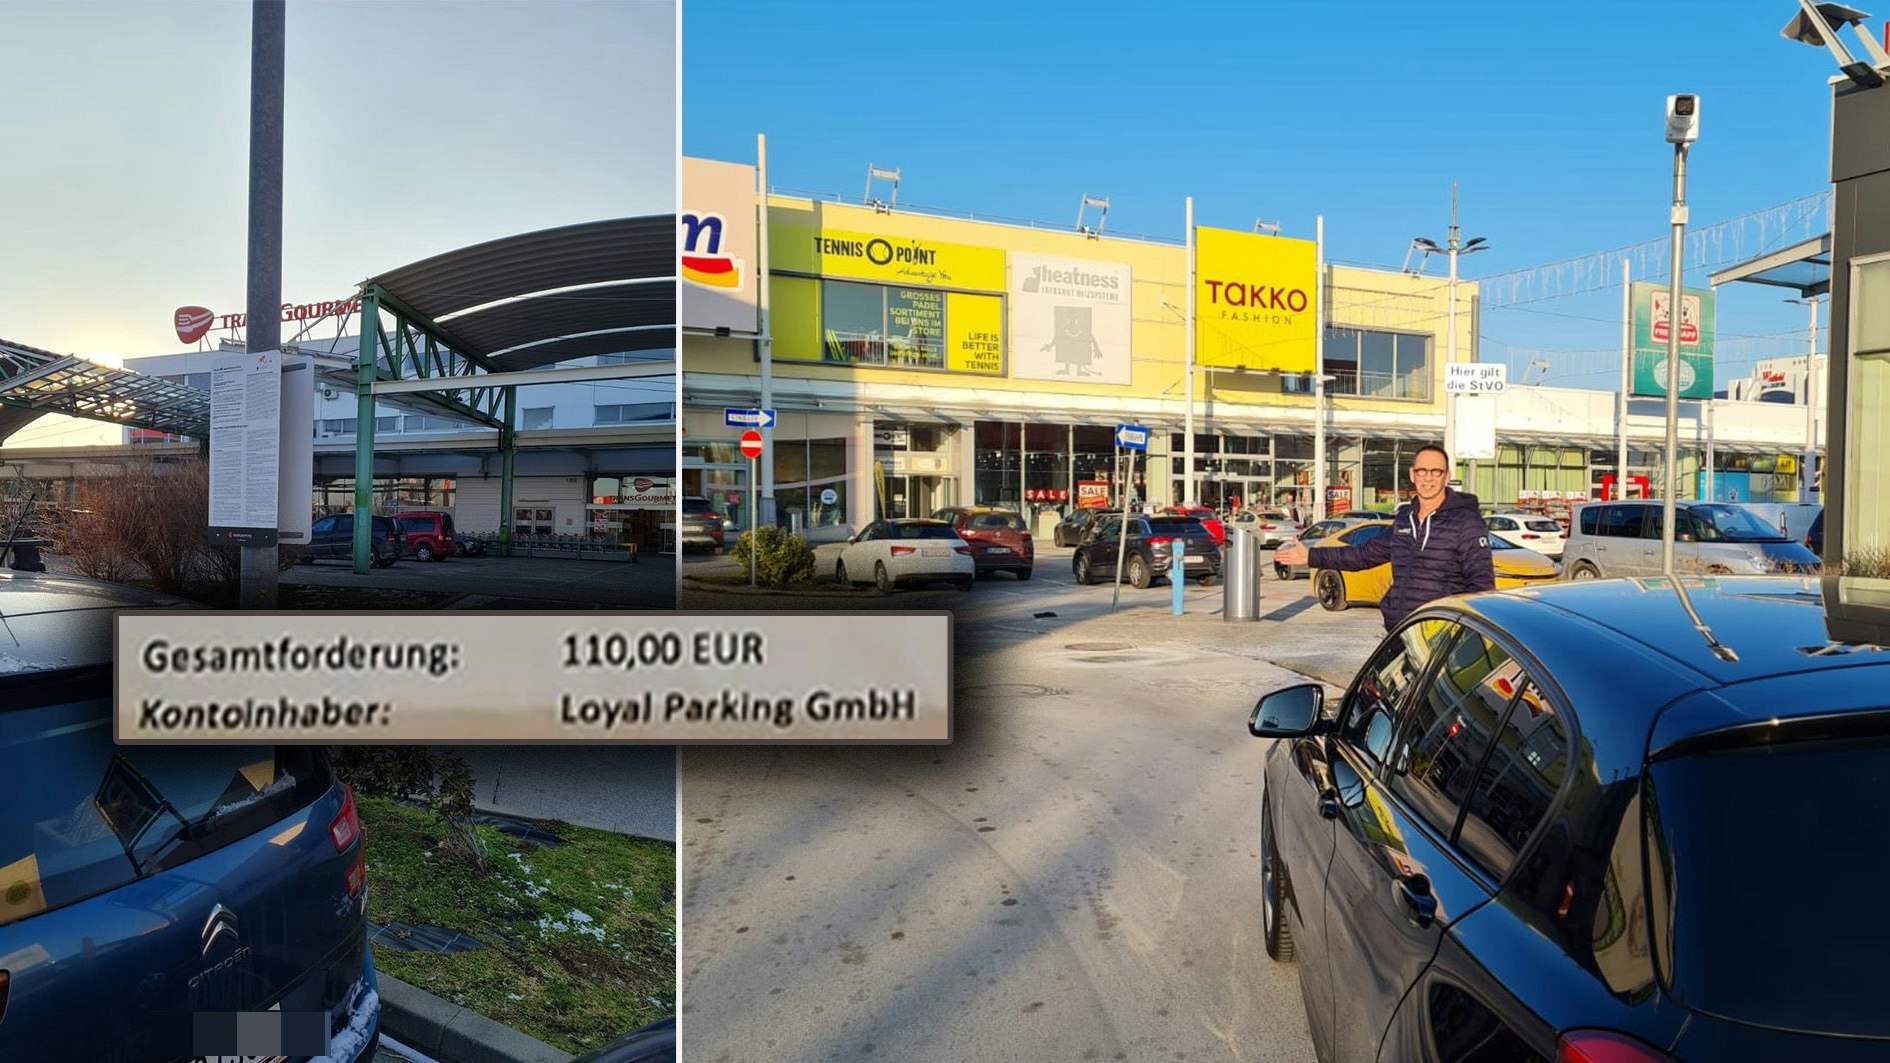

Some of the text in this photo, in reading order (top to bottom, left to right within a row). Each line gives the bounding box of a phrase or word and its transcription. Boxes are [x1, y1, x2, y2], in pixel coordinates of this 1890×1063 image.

[813, 236, 936, 265] TENNIS POINT
[1042, 265, 1119, 290] heatness
[900, 290, 941, 302] GROSSES
[912, 301, 941, 311] PADEL
[889, 307, 941, 320] SORTIMENT
[1221, 311, 1292, 326] FASHION
[911, 327, 941, 337] STORE
[969, 332, 999, 342] LIFE IS
[962, 341, 999, 352] BETTER
[974, 351, 999, 361] WITH
[966, 360, 999, 371] TENNIS
[1450, 366, 1500, 379] Hier gilt
[1447, 380, 1504, 391] die StVO
[1026, 489, 1067, 500] SALE
[1081, 486, 1106, 497] SALE
